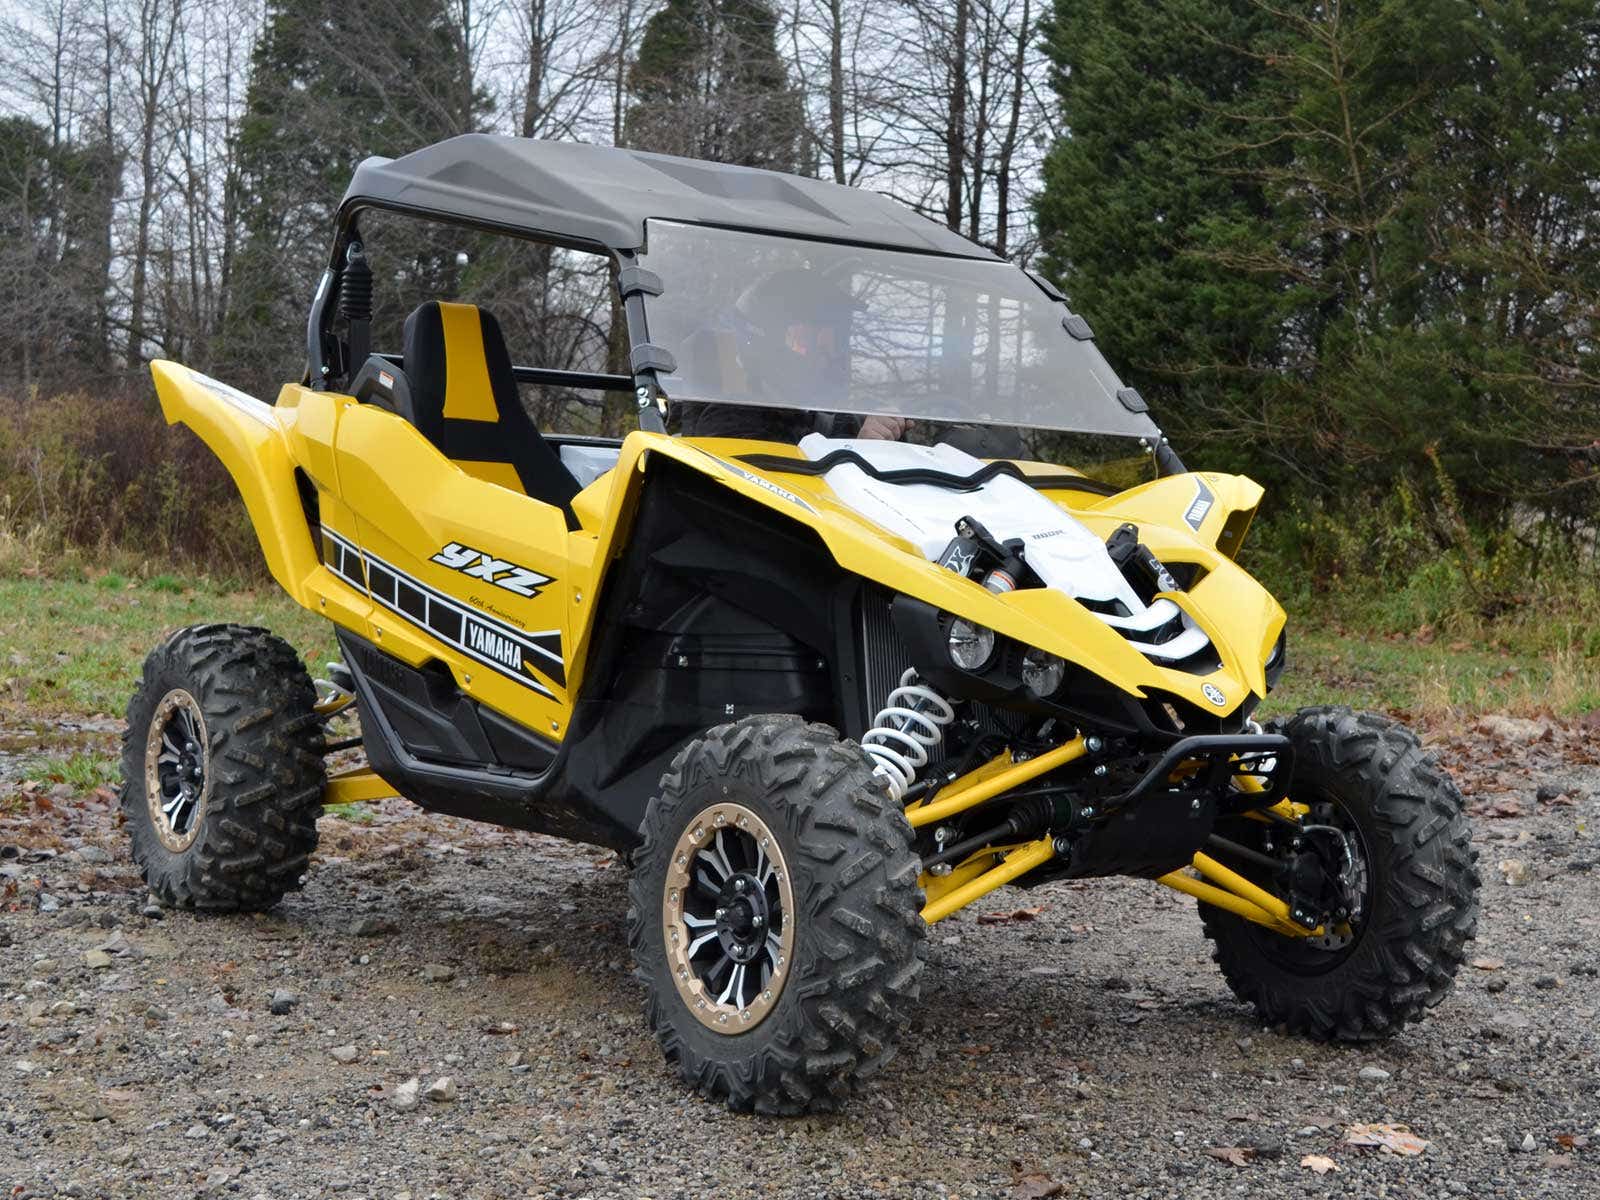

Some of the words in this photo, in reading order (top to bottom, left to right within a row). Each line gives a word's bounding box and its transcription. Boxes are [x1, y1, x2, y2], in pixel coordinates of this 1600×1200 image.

[743, 471, 797, 502] YAMAHA
[429, 541, 556, 599] YXZ
[469, 622, 522, 671] YAMAHA
